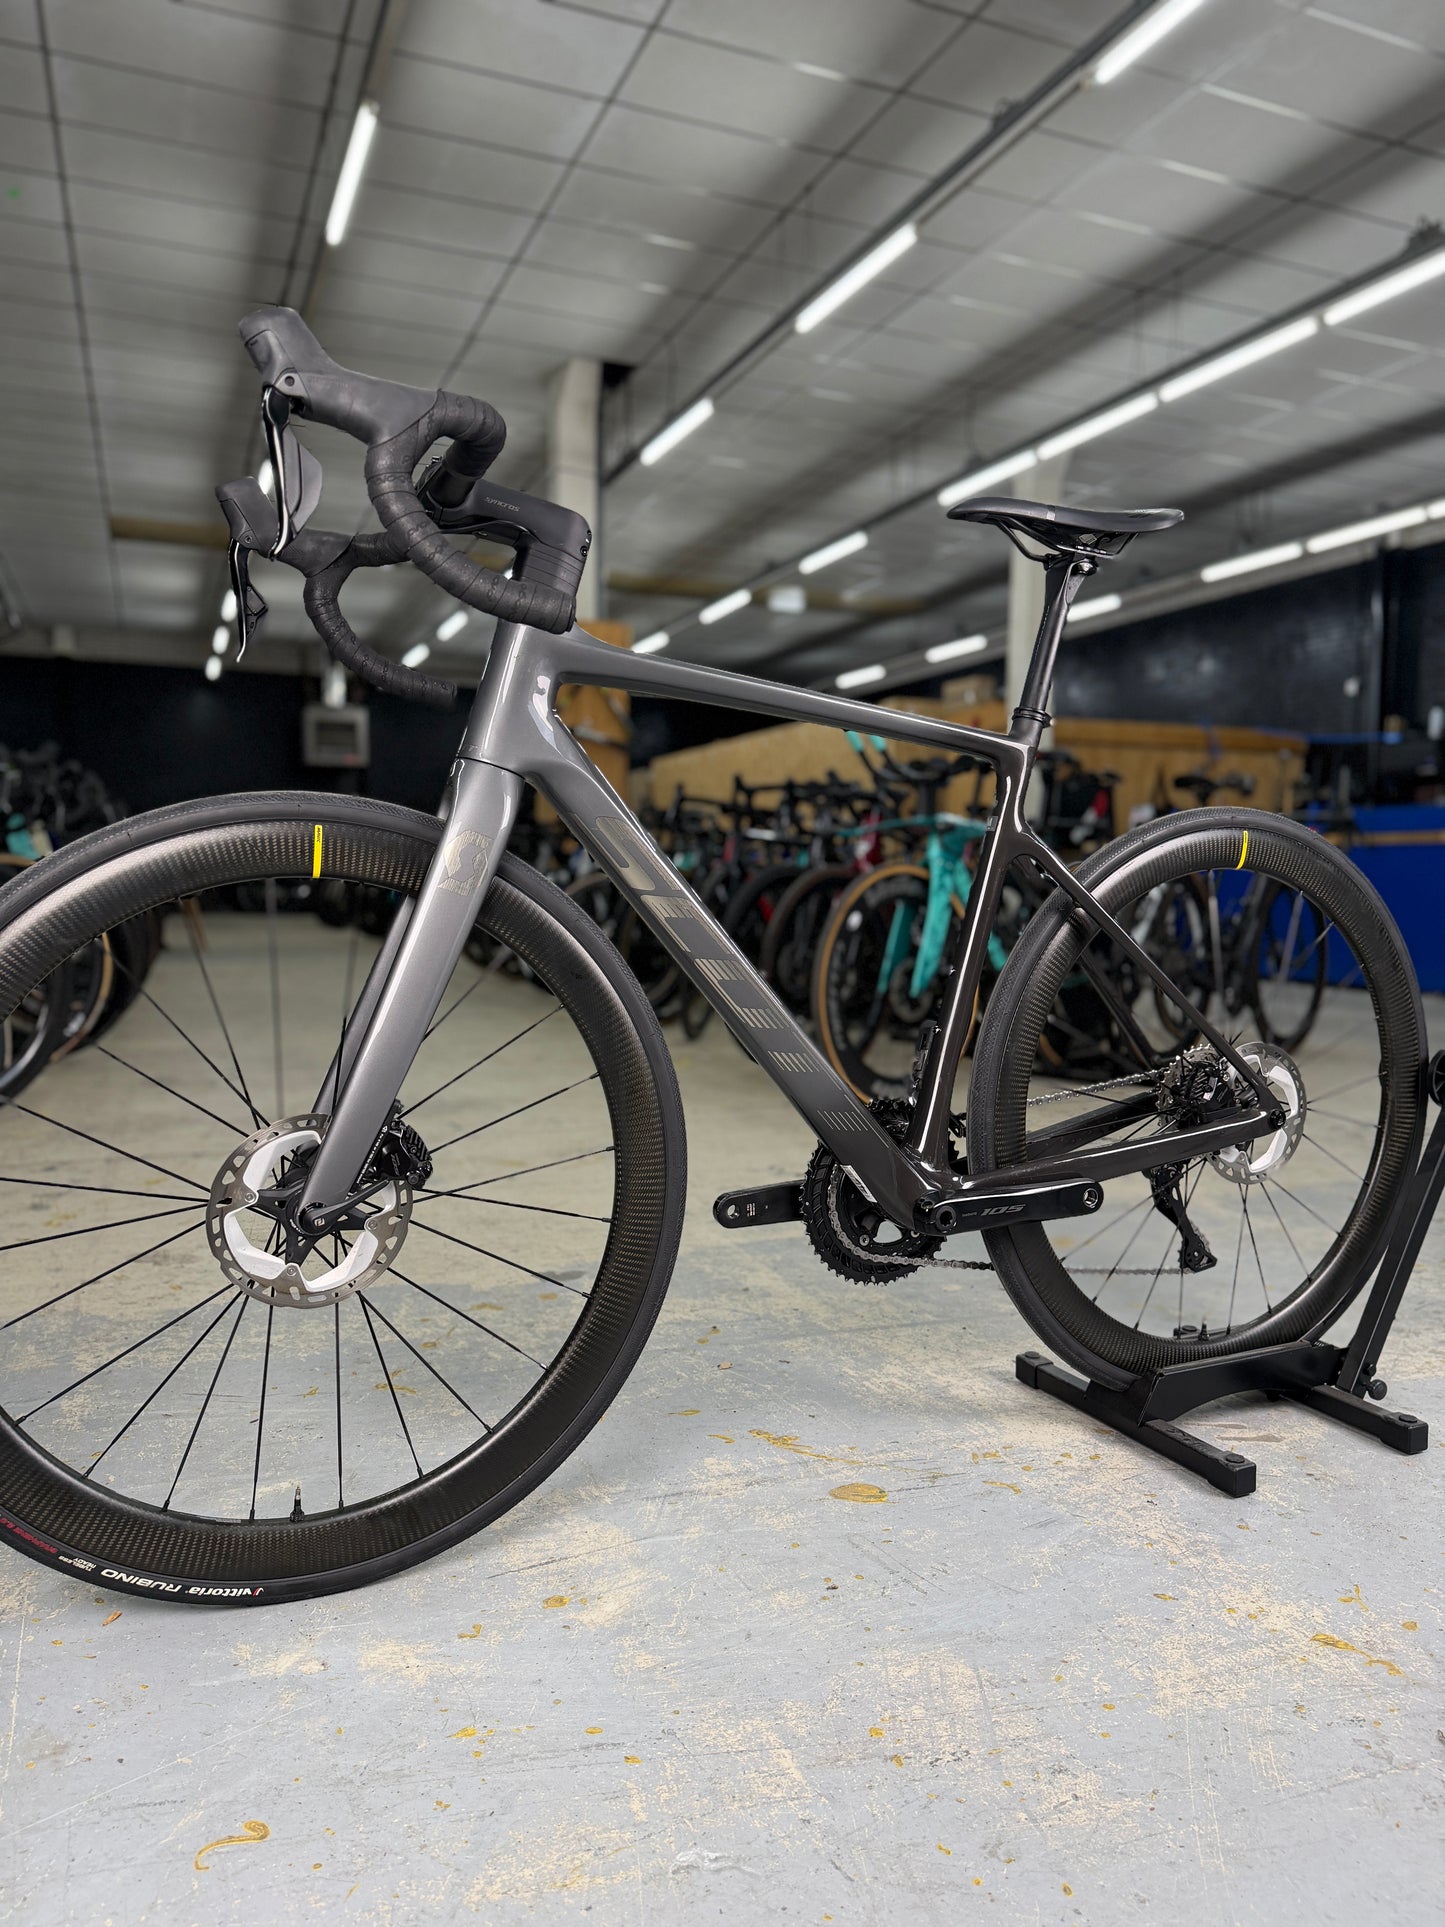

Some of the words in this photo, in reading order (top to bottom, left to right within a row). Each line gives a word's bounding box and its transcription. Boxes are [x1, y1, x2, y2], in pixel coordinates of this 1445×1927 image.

[980, 1204, 1026, 1217] 105
[73, 1557, 97, 1569] READY
[100, 1568, 182, 1592] RUBINO
[188, 1585, 252, 1597] vittoria
